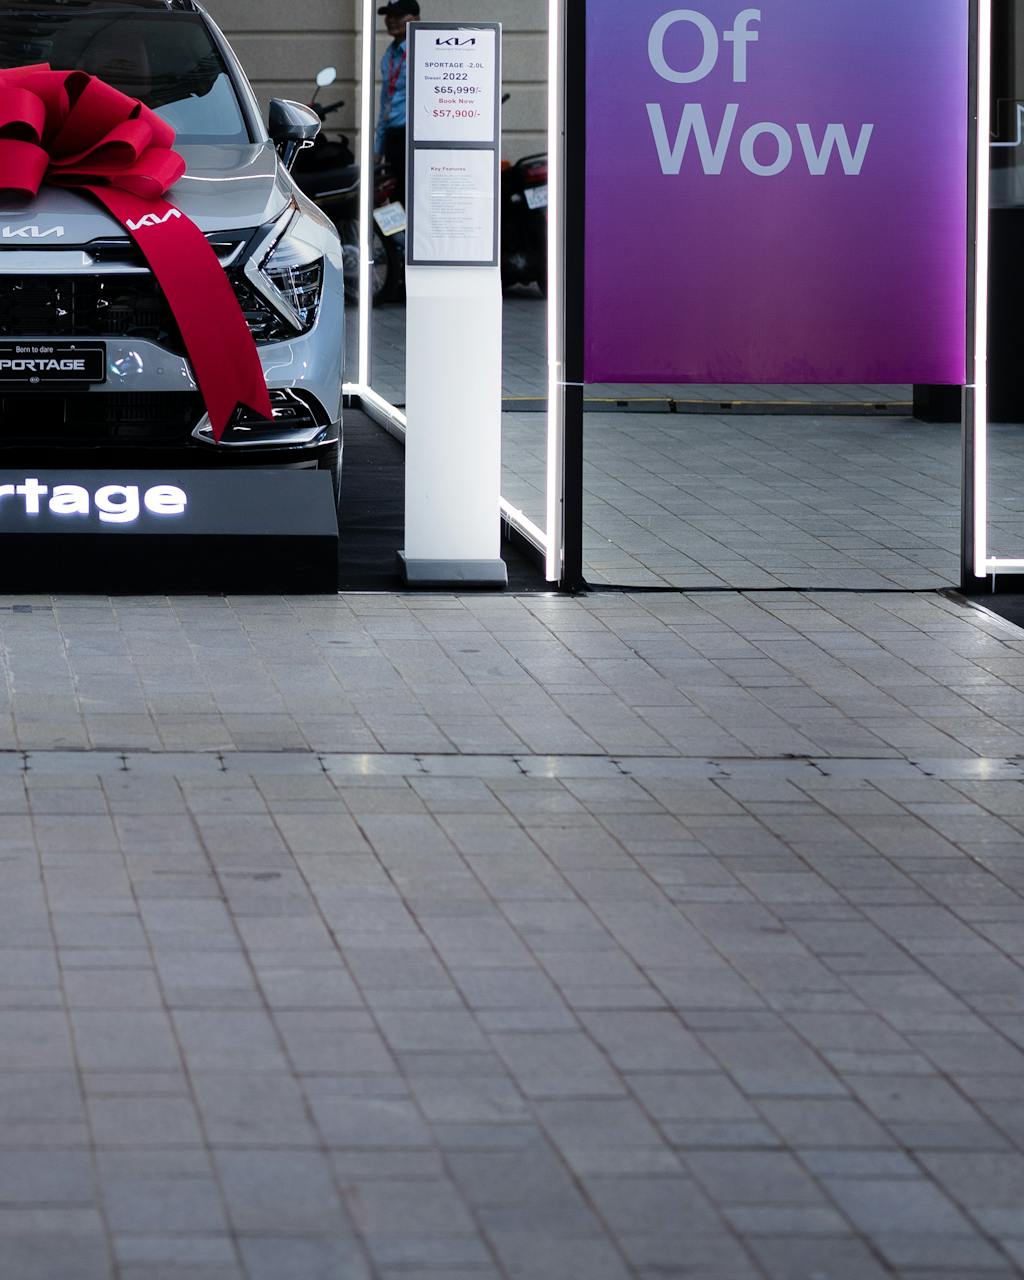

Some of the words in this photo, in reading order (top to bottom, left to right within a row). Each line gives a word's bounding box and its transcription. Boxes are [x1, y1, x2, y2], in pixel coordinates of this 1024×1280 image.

[435, 37, 476, 46] KIA
[647, 8, 762, 84] Of
[442, 72, 468, 81] 2022
[645, 102, 874, 177] Wow
[125, 208, 182, 231] KIA
[1, 225, 65, 238] KIA
[16, 345, 31, 353] Born
[32, 345, 39, 353] to
[39, 345, 54, 353] dare
